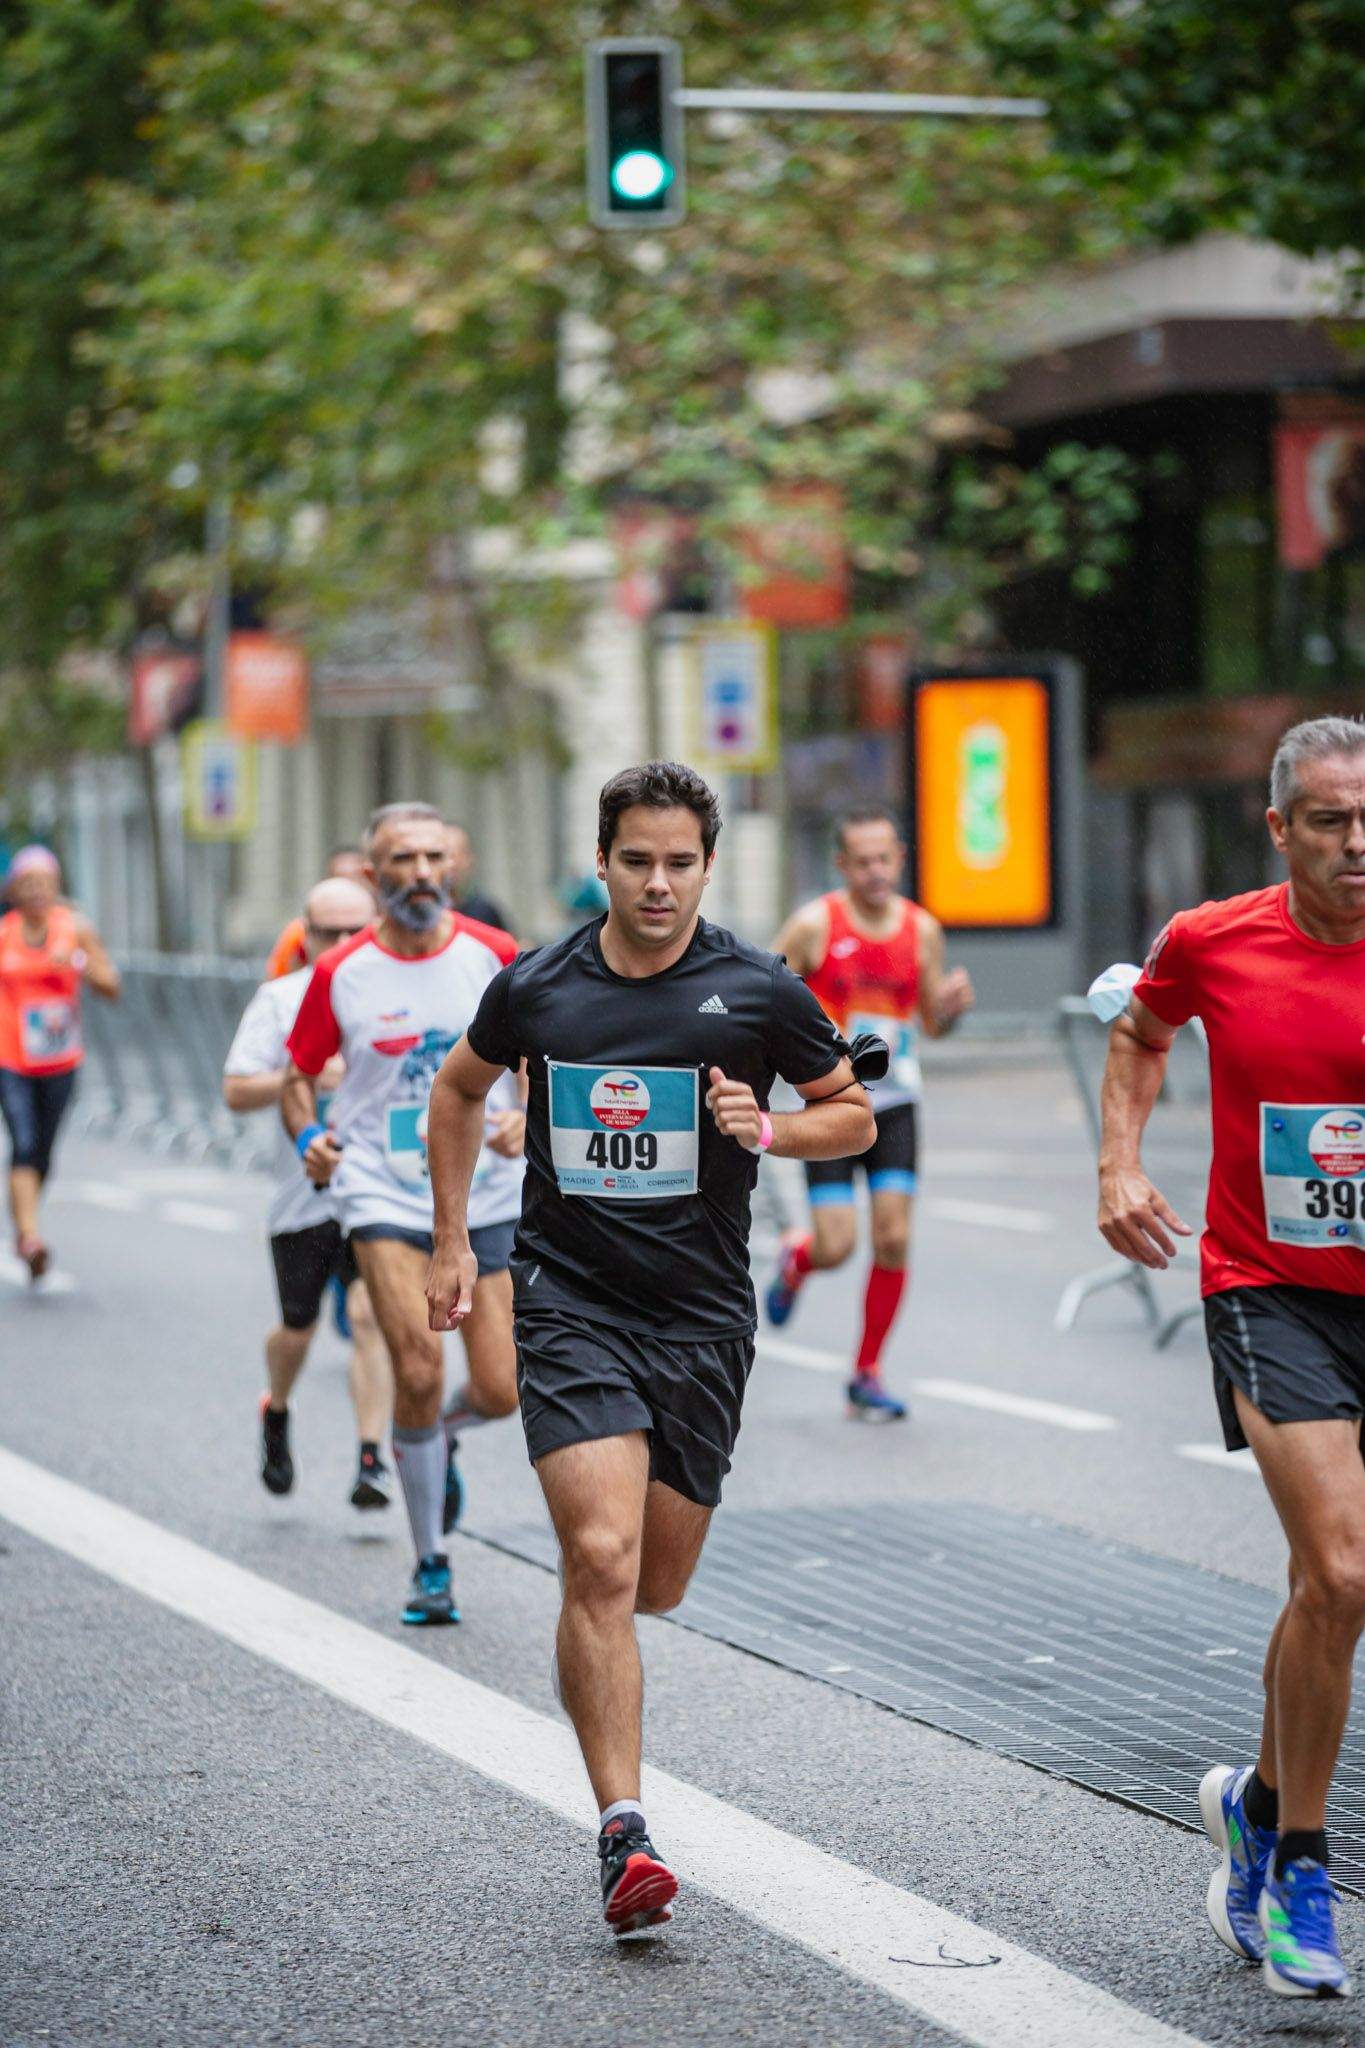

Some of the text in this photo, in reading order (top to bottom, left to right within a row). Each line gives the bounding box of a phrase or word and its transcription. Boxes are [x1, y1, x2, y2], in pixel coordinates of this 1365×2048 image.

[698, 1005, 728, 1014] adidas
[586, 1132, 658, 1171] 409
[563, 1176, 596, 1185] MADRID
[1305, 1179, 1365, 1221] 39
